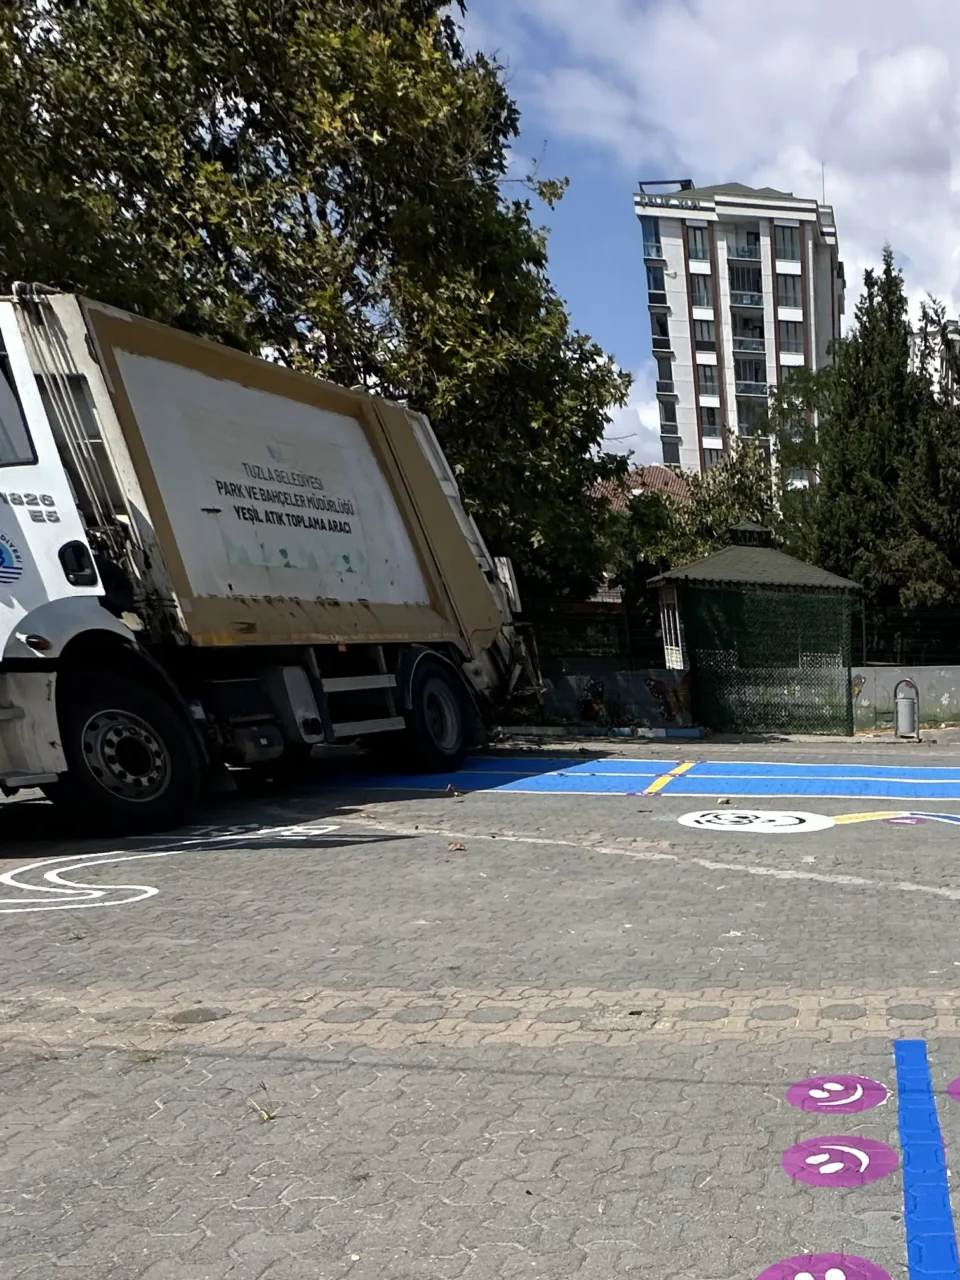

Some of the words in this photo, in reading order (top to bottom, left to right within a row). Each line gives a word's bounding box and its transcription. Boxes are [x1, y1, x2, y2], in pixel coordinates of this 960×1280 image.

[242, 462, 274, 482] TUZLA
[216, 480, 247, 499] PARK
[244, 485, 260, 501] VE
[260, 487, 309, 509] BAHÇELER
[306, 493, 355, 516] MÜDÜRLÜĞÜ
[28, 509, 61, 524] E5
[233, 504, 264, 526] YEŞİL
[265, 510, 286, 527] ATIK
[285, 513, 328, 532] TOPLAMA
[327, 520, 352, 535] ARACI
